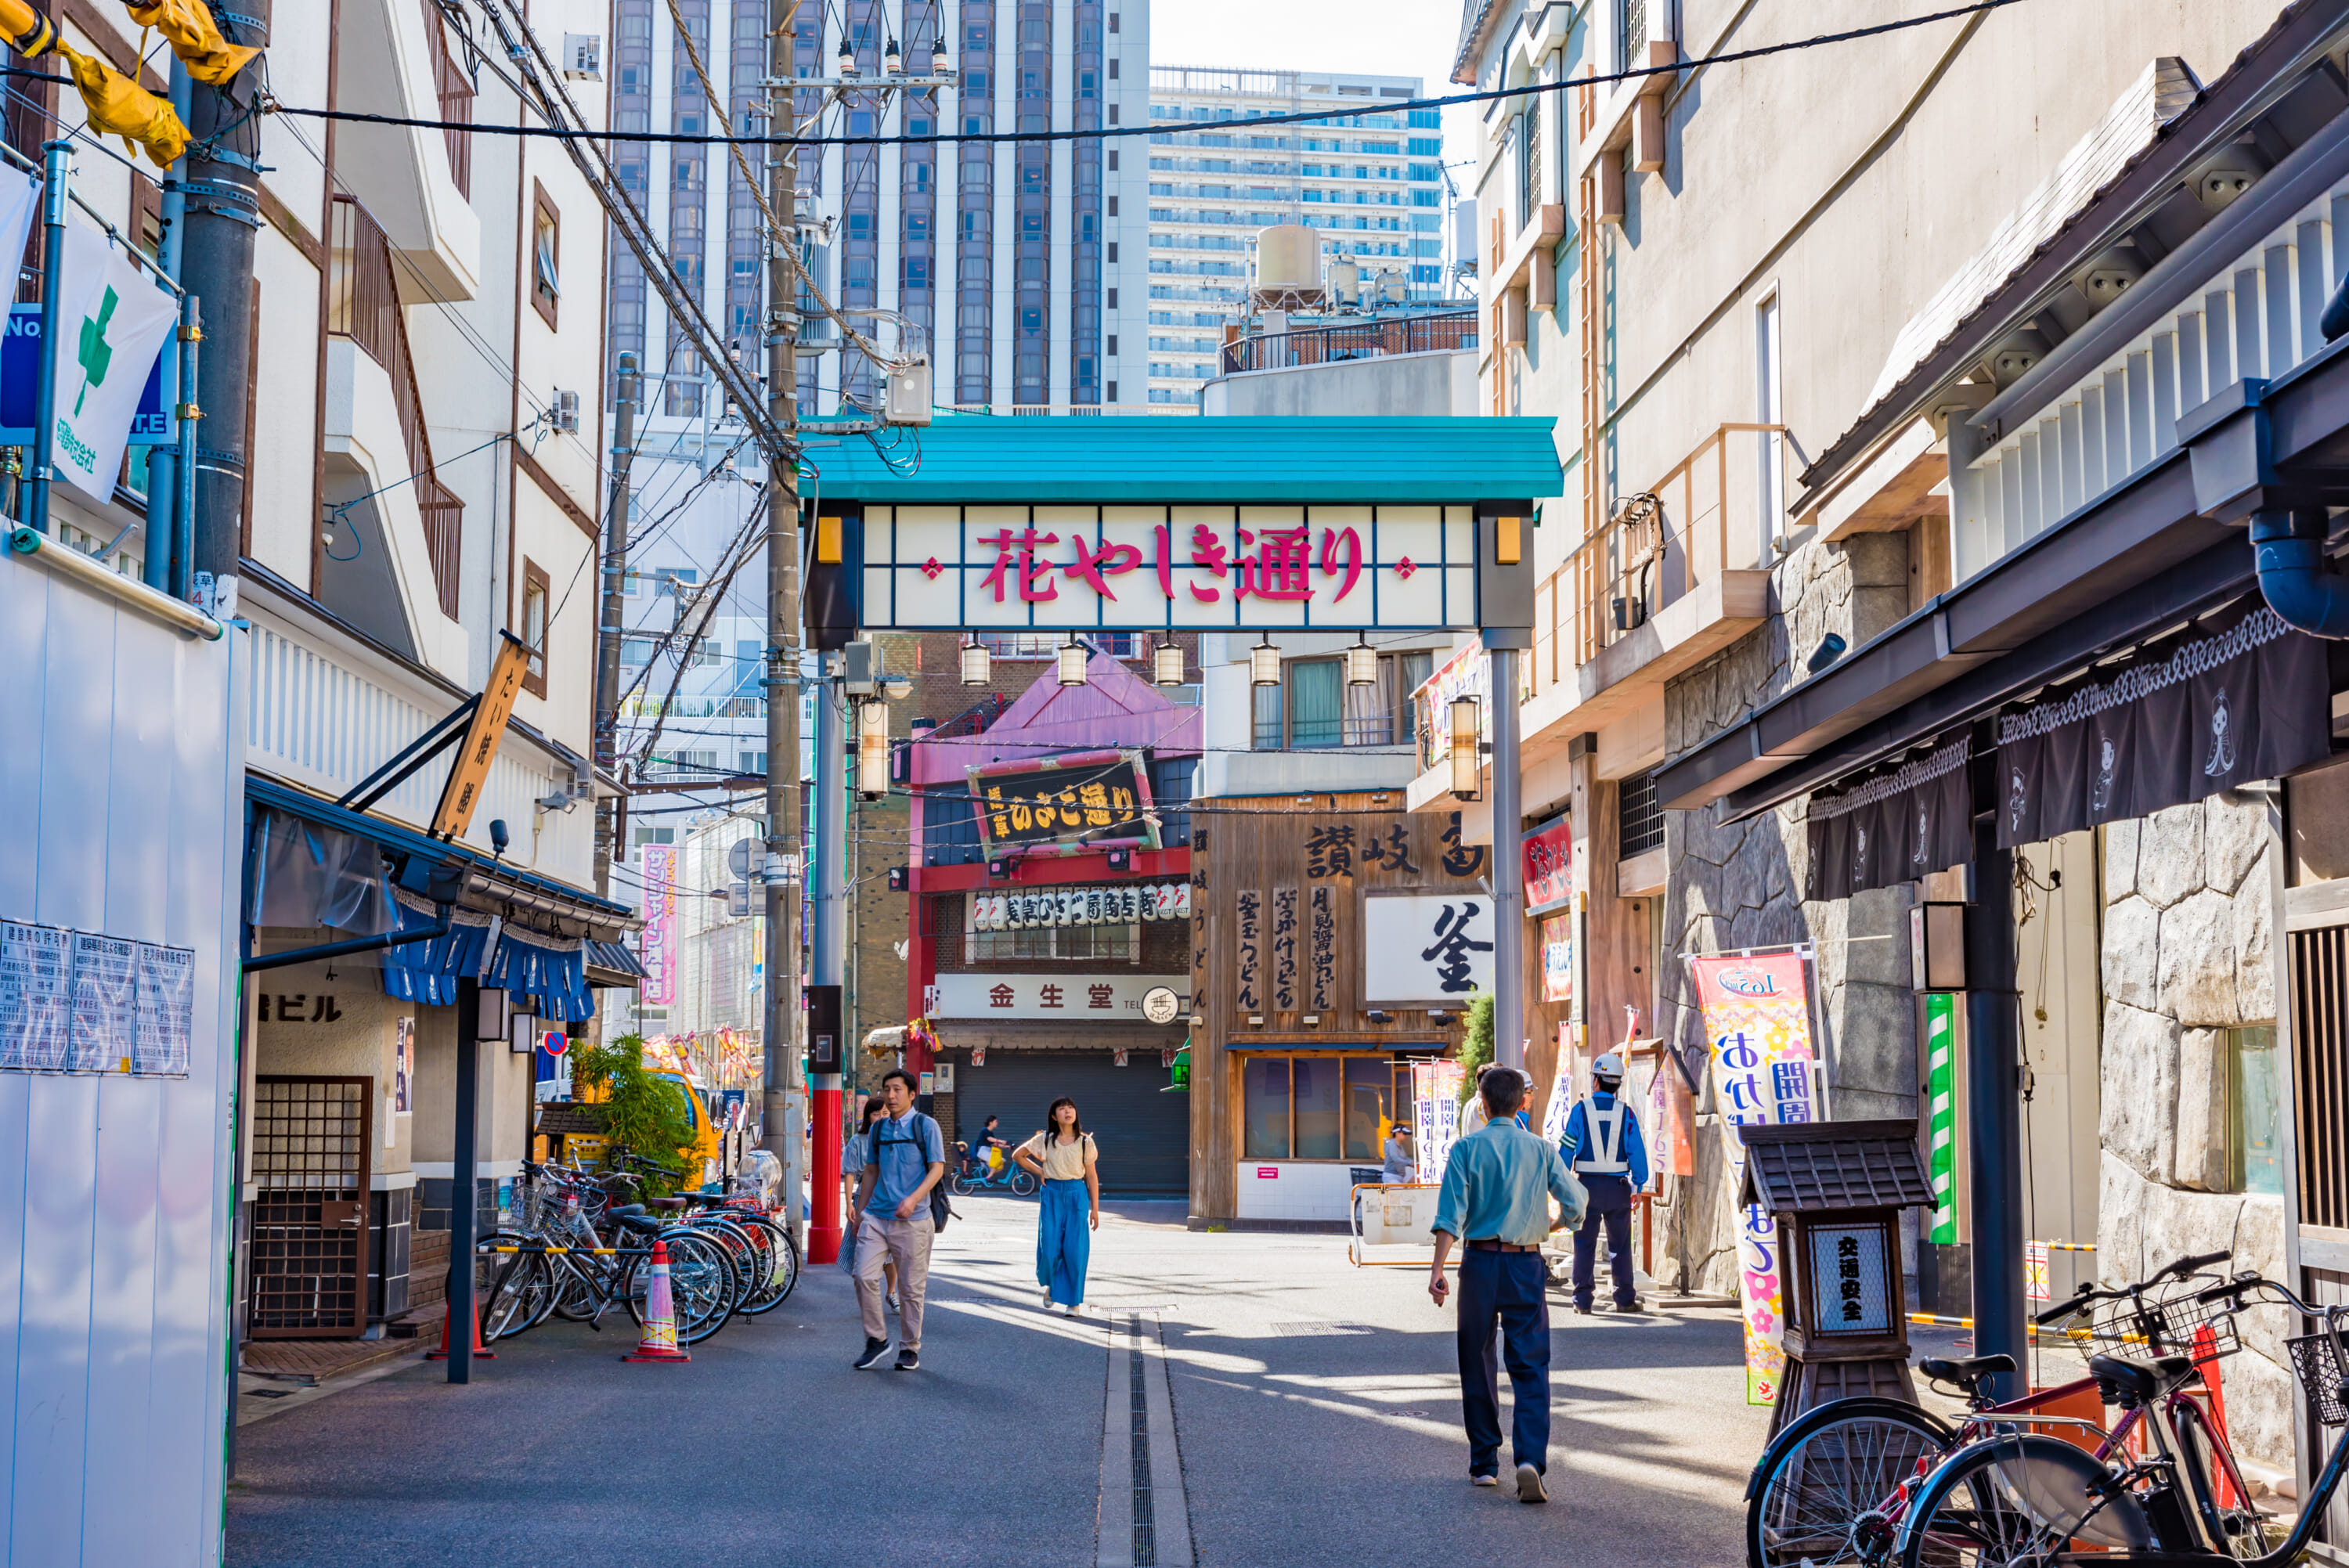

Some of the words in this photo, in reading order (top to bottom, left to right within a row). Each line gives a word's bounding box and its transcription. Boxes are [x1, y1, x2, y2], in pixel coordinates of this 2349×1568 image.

[976, 524, 1363, 604] 花やしき通り
[645, 849, 666, 1000] サンシャイン浅草店
[1238, 892, 1261, 1009] 釜玉うどん
[1275, 889, 1297, 1008] ぶっかけうどん
[1421, 902, 1494, 993] 釜
[990, 982, 1113, 1009] 金生堂
[1124, 1000, 1141, 1009] TEL
[1838, 1236, 1863, 1322] 交通安全
